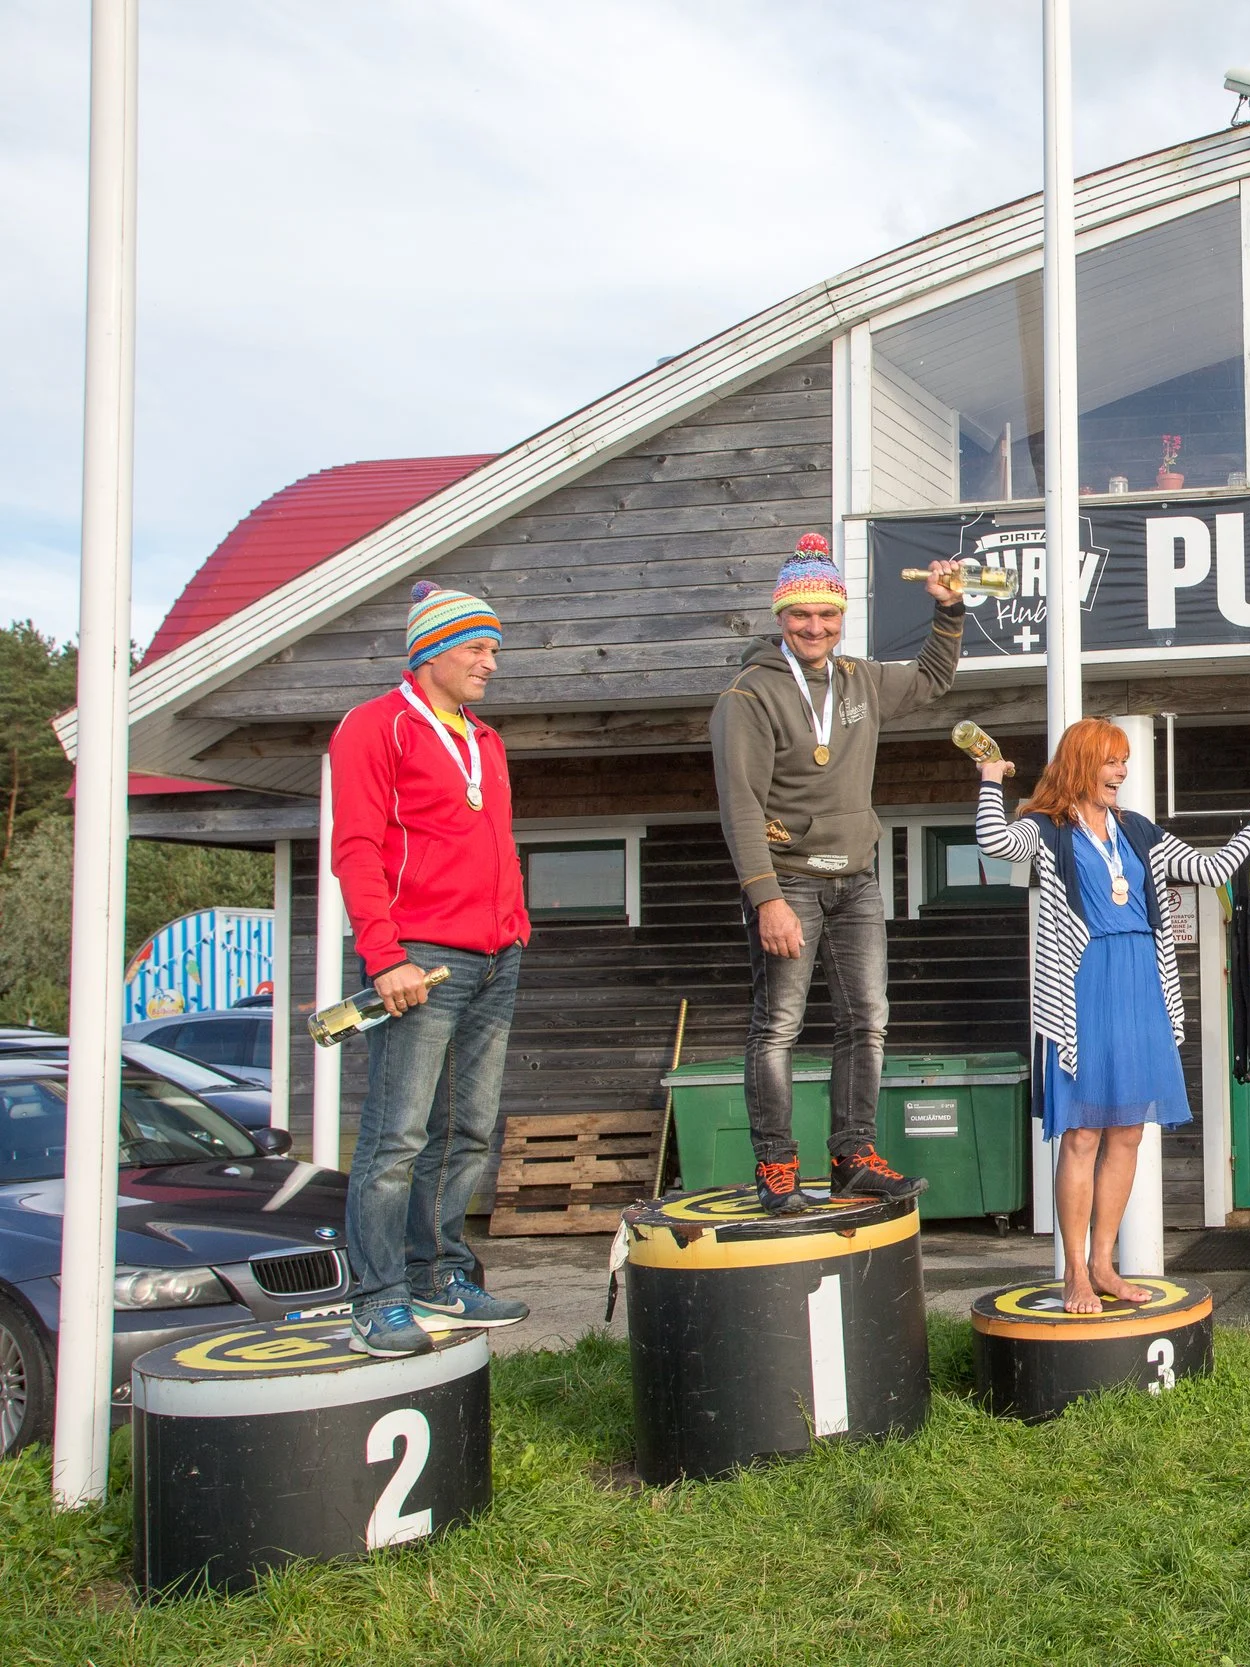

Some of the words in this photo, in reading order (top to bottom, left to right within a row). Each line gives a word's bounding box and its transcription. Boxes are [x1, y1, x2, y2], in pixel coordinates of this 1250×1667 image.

[807, 1274, 849, 1437] 1
[1147, 1338, 1175, 1399] 3
[366, 1408, 432, 1551] 2
